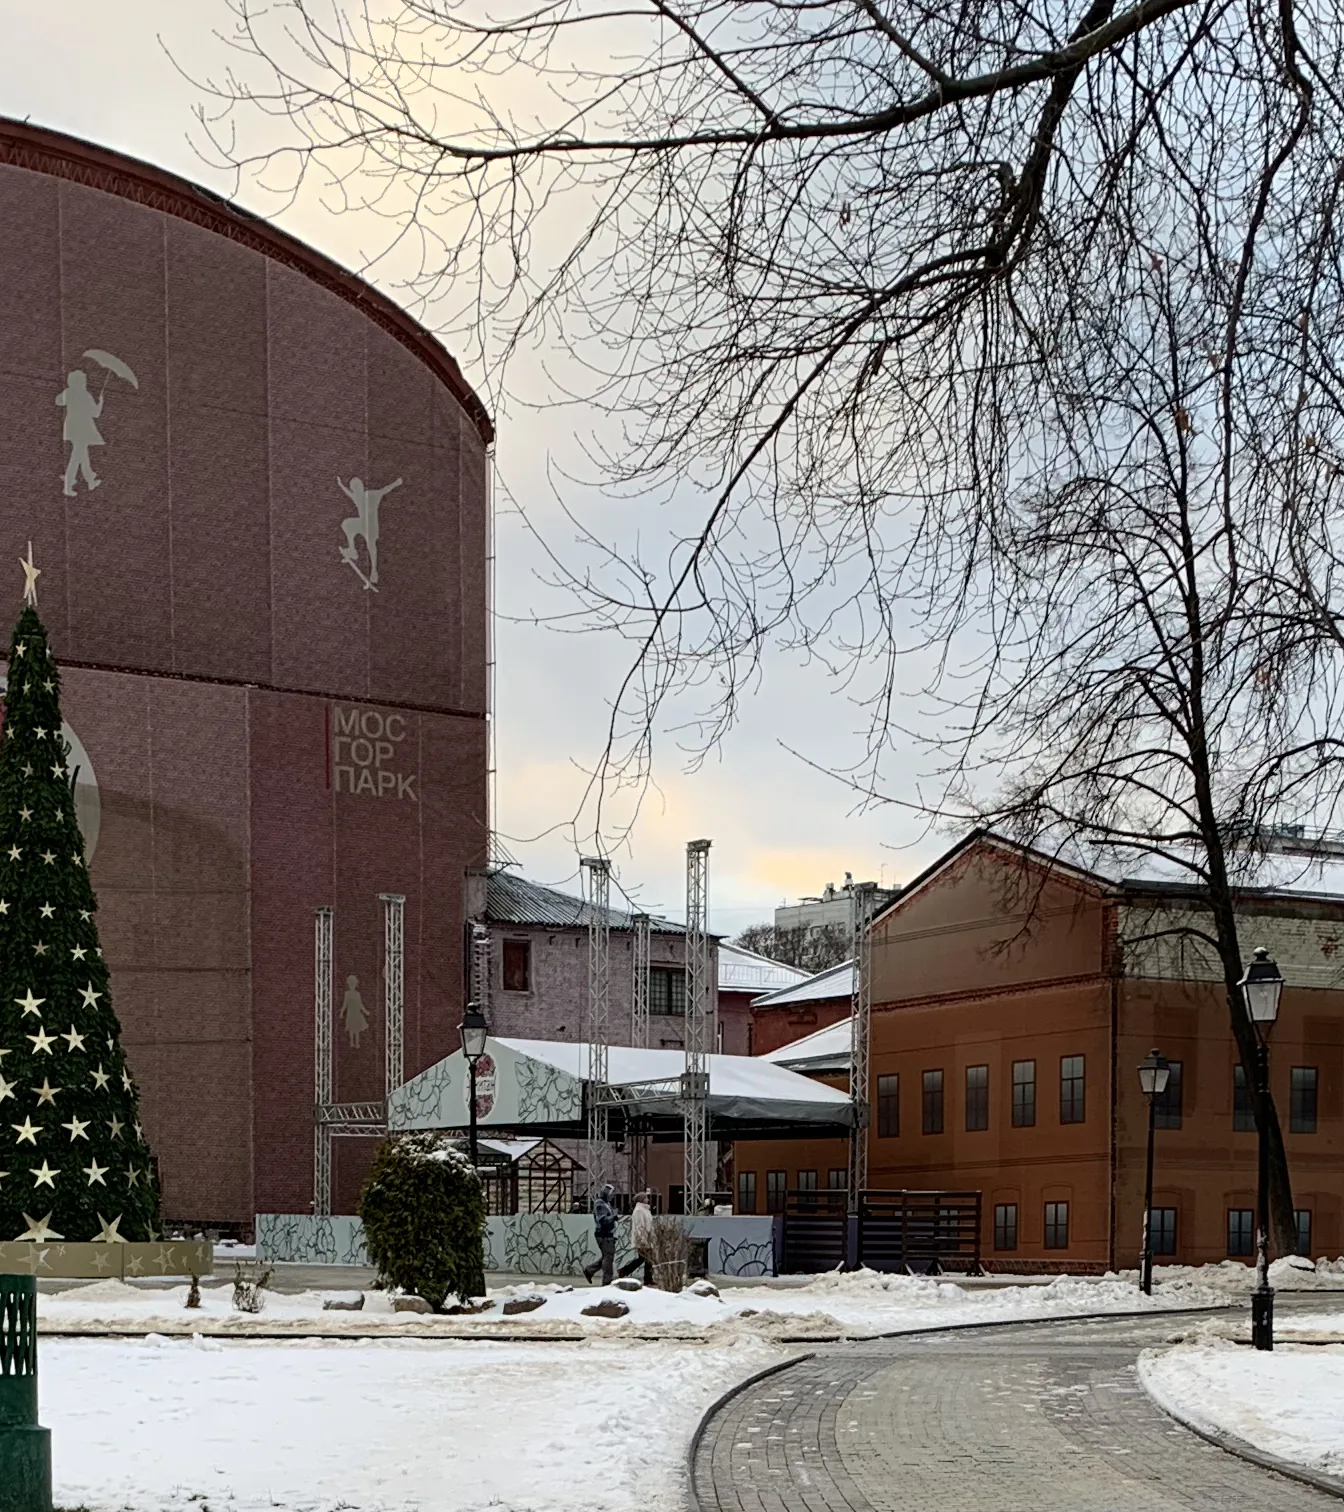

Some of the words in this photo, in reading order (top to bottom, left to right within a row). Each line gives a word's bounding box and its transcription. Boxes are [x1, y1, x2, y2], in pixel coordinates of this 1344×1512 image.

[335, 706, 407, 741] МОС
[335, 736, 395, 767] ГОР
[335, 765, 418, 801] ПАРК
